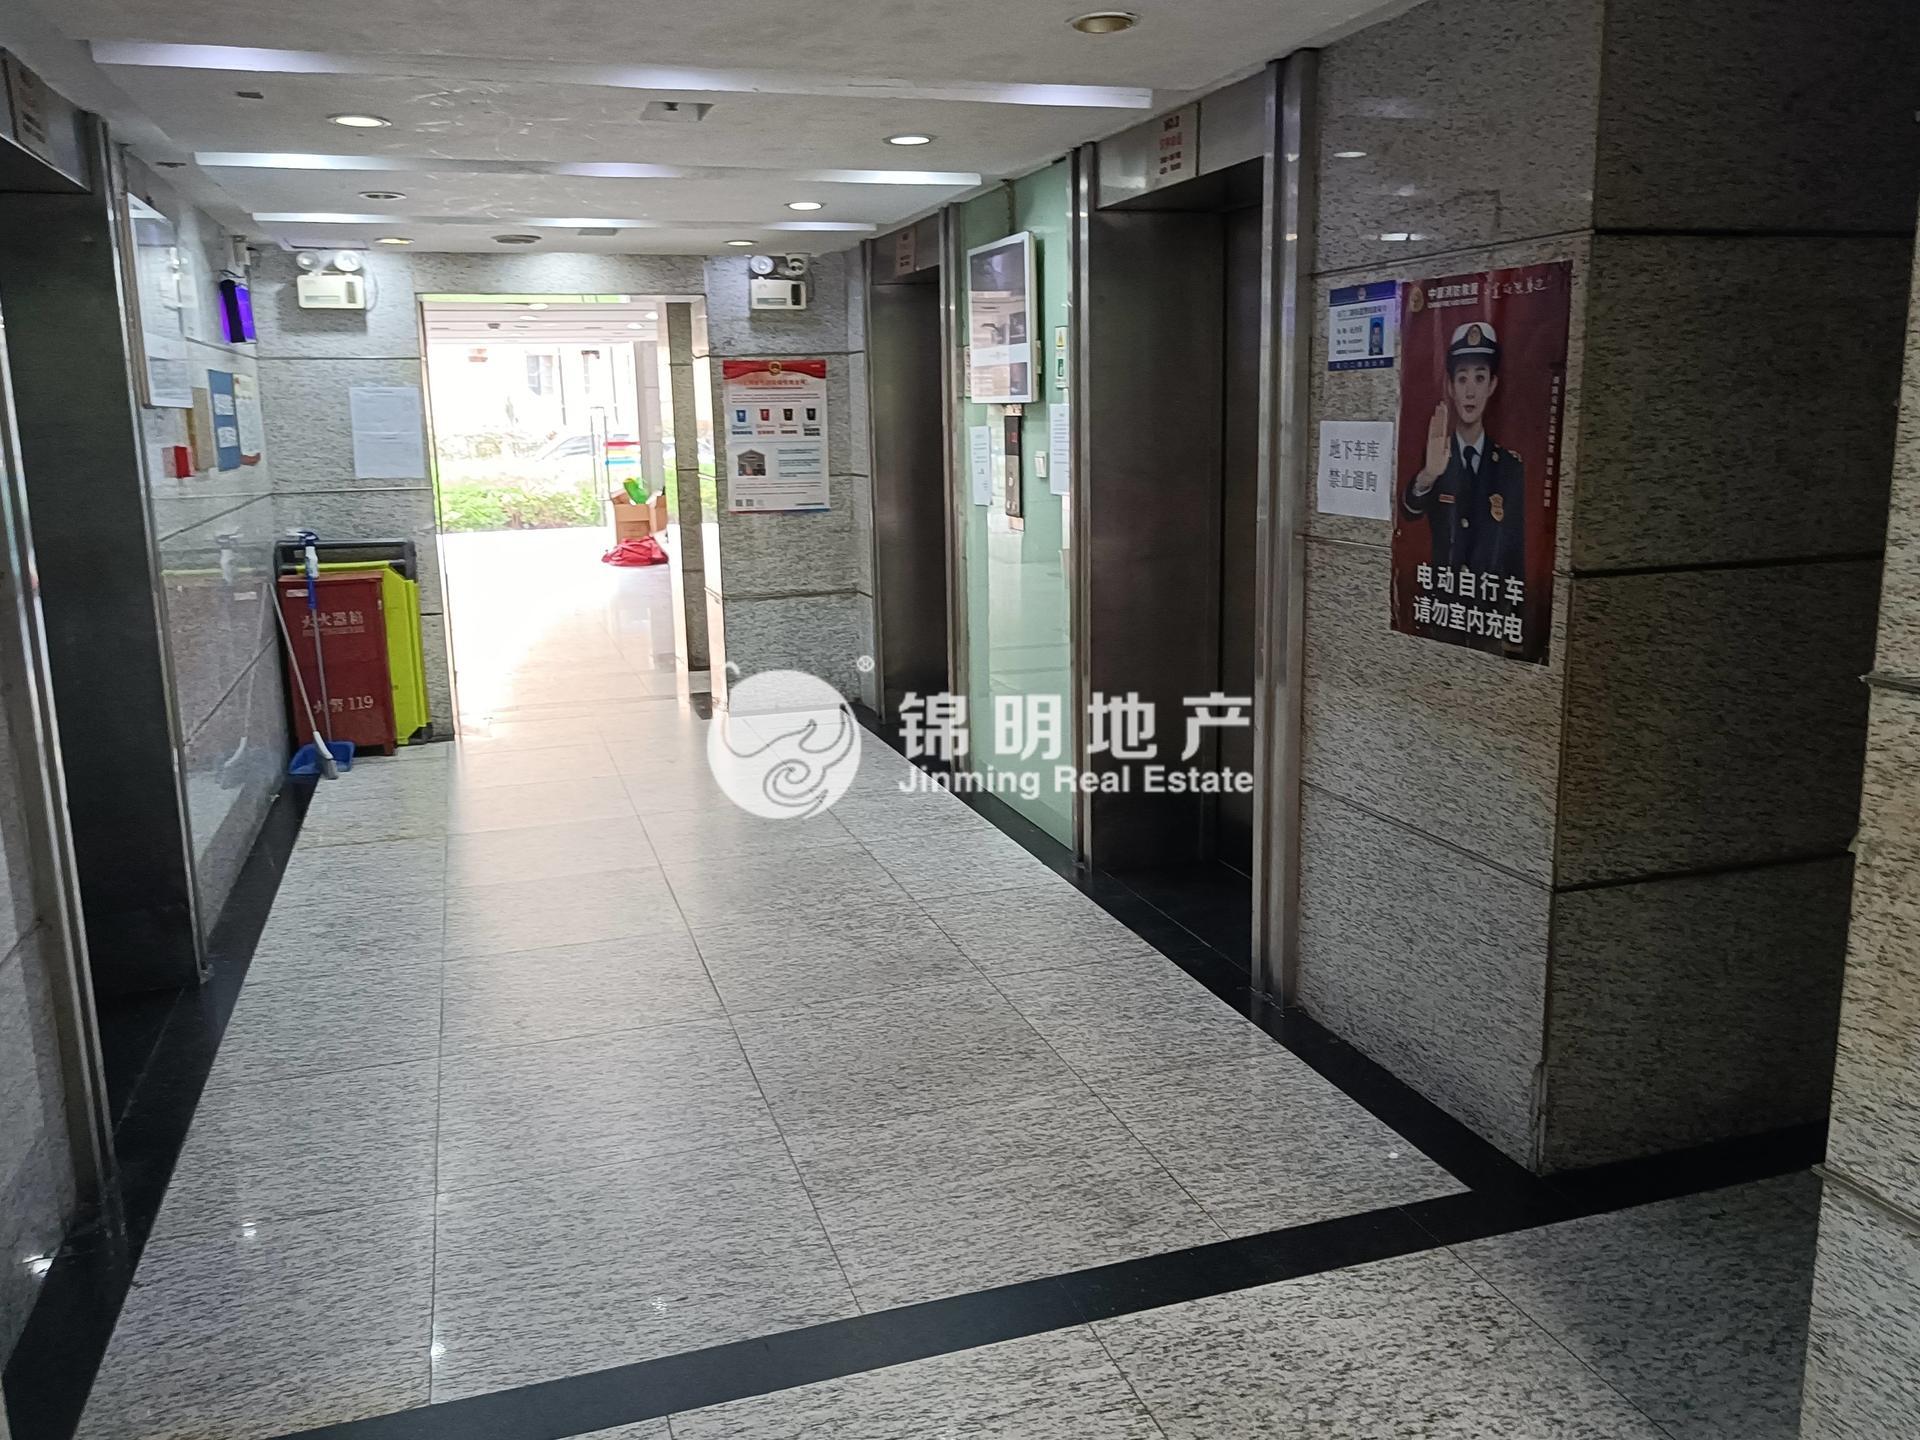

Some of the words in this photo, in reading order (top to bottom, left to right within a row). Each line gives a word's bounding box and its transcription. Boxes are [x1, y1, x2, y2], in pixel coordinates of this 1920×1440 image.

[1329, 439, 1380, 461] 地下车库
[1328, 468, 1378, 493] 禁止遛狗
[1416, 562, 1525, 606] 电动自行车
[1413, 595, 1524, 644] 请勿室内充电
